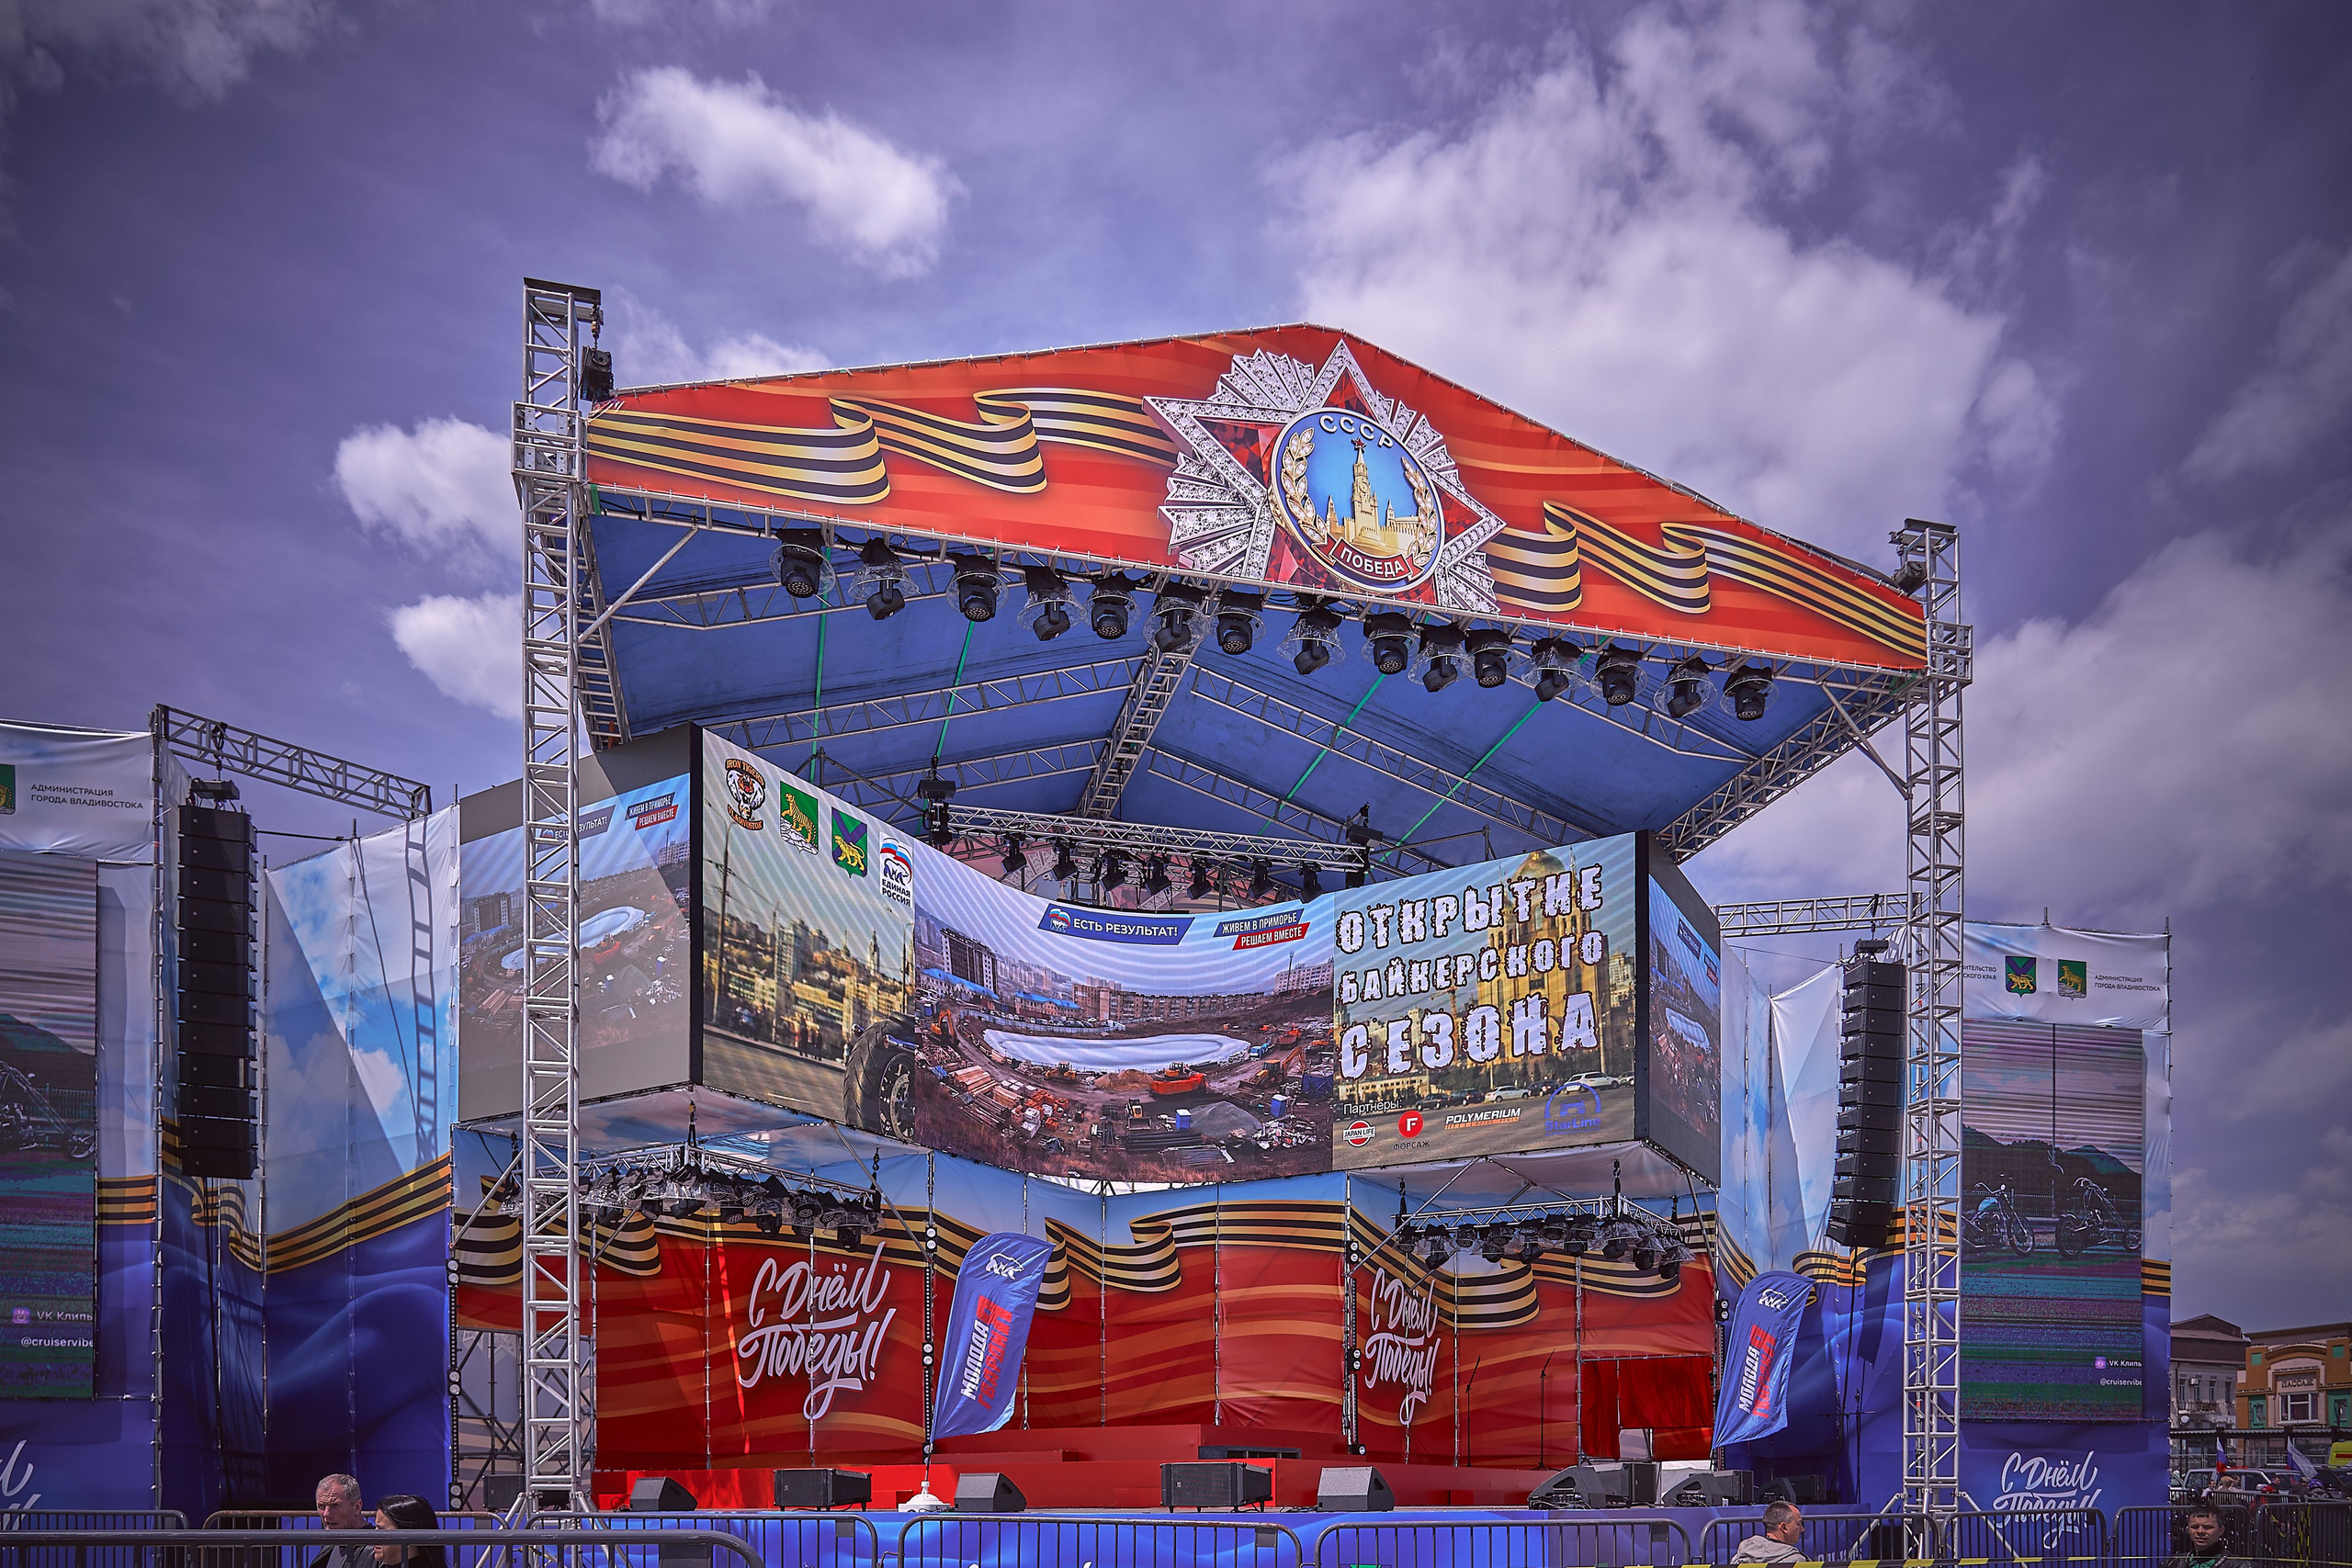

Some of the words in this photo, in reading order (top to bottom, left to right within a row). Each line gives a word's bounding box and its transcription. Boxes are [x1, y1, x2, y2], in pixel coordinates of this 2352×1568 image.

[1319, 415, 1394, 448] СССР
[1340, 547, 1405, 578] ПОБЕДА
[726, 760, 741, 769] IRON
[742, 762, 764, 786] TIGERS
[31, 784, 113, 796] АДМИНИСТРАЦИЯ
[31, 795, 67, 804] ГОРОДА
[70, 799, 143, 809] ВЛАДИВОСТОКА
[882, 878, 910, 898] ЕДИНАЯ
[882, 887, 910, 908] РОССИЯ
[1337, 863, 1603, 954] ОТКРЫТИЕ
[1073, 918, 1103, 931] ЕСТЬ
[1105, 923, 1179, 937] РЕЗУЛЬТАТ!
[1222, 920, 1250, 934] ЖИВЕМ
[1252, 920, 1258, 931] В
[1259, 912, 1297, 930] ПРИМОРЬЕ
[1240, 932, 1272, 947] РЕШАЕМ
[1273, 927, 1303, 942] ВМЕСТЕ
[1339, 931, 1604, 1005] БАЙКЕРСКОГО
[2095, 975, 2143, 983] АДМИНИСТРАЦИЯ
[2116, 984, 2161, 992] ВЛАДИВОСТОКА
[1339, 990, 1599, 1079] СЕЗОНА
[1343, 1100, 1402, 1115] Партнеры:
[1445, 1108, 1521, 1124] POLYMERIUM
[1344, 1128, 1362, 1137] JAPAN
[1363, 1127, 1374, 1135] LIFE
[1406, 1117, 1419, 1132] F
[1544, 1117, 1601, 1131] StarLine
[1393, 1141, 1430, 1151] ФОРСАЖ
[749, 1258, 777, 1327] С
[775, 1241, 890, 1319] Днём
[1370, 1268, 1385, 1331] С
[1384, 1280, 1438, 1338] Днём
[37, 1311, 52, 1320] VK
[738, 1308, 897, 1420] Победы!
[1365, 1333, 1442, 1425] Победы!
[2281, 1379, 2313, 1389] ПАССАЖ
[2001, 1451, 2021, 1493] С
[2020, 1450, 2098, 1491] Днём
